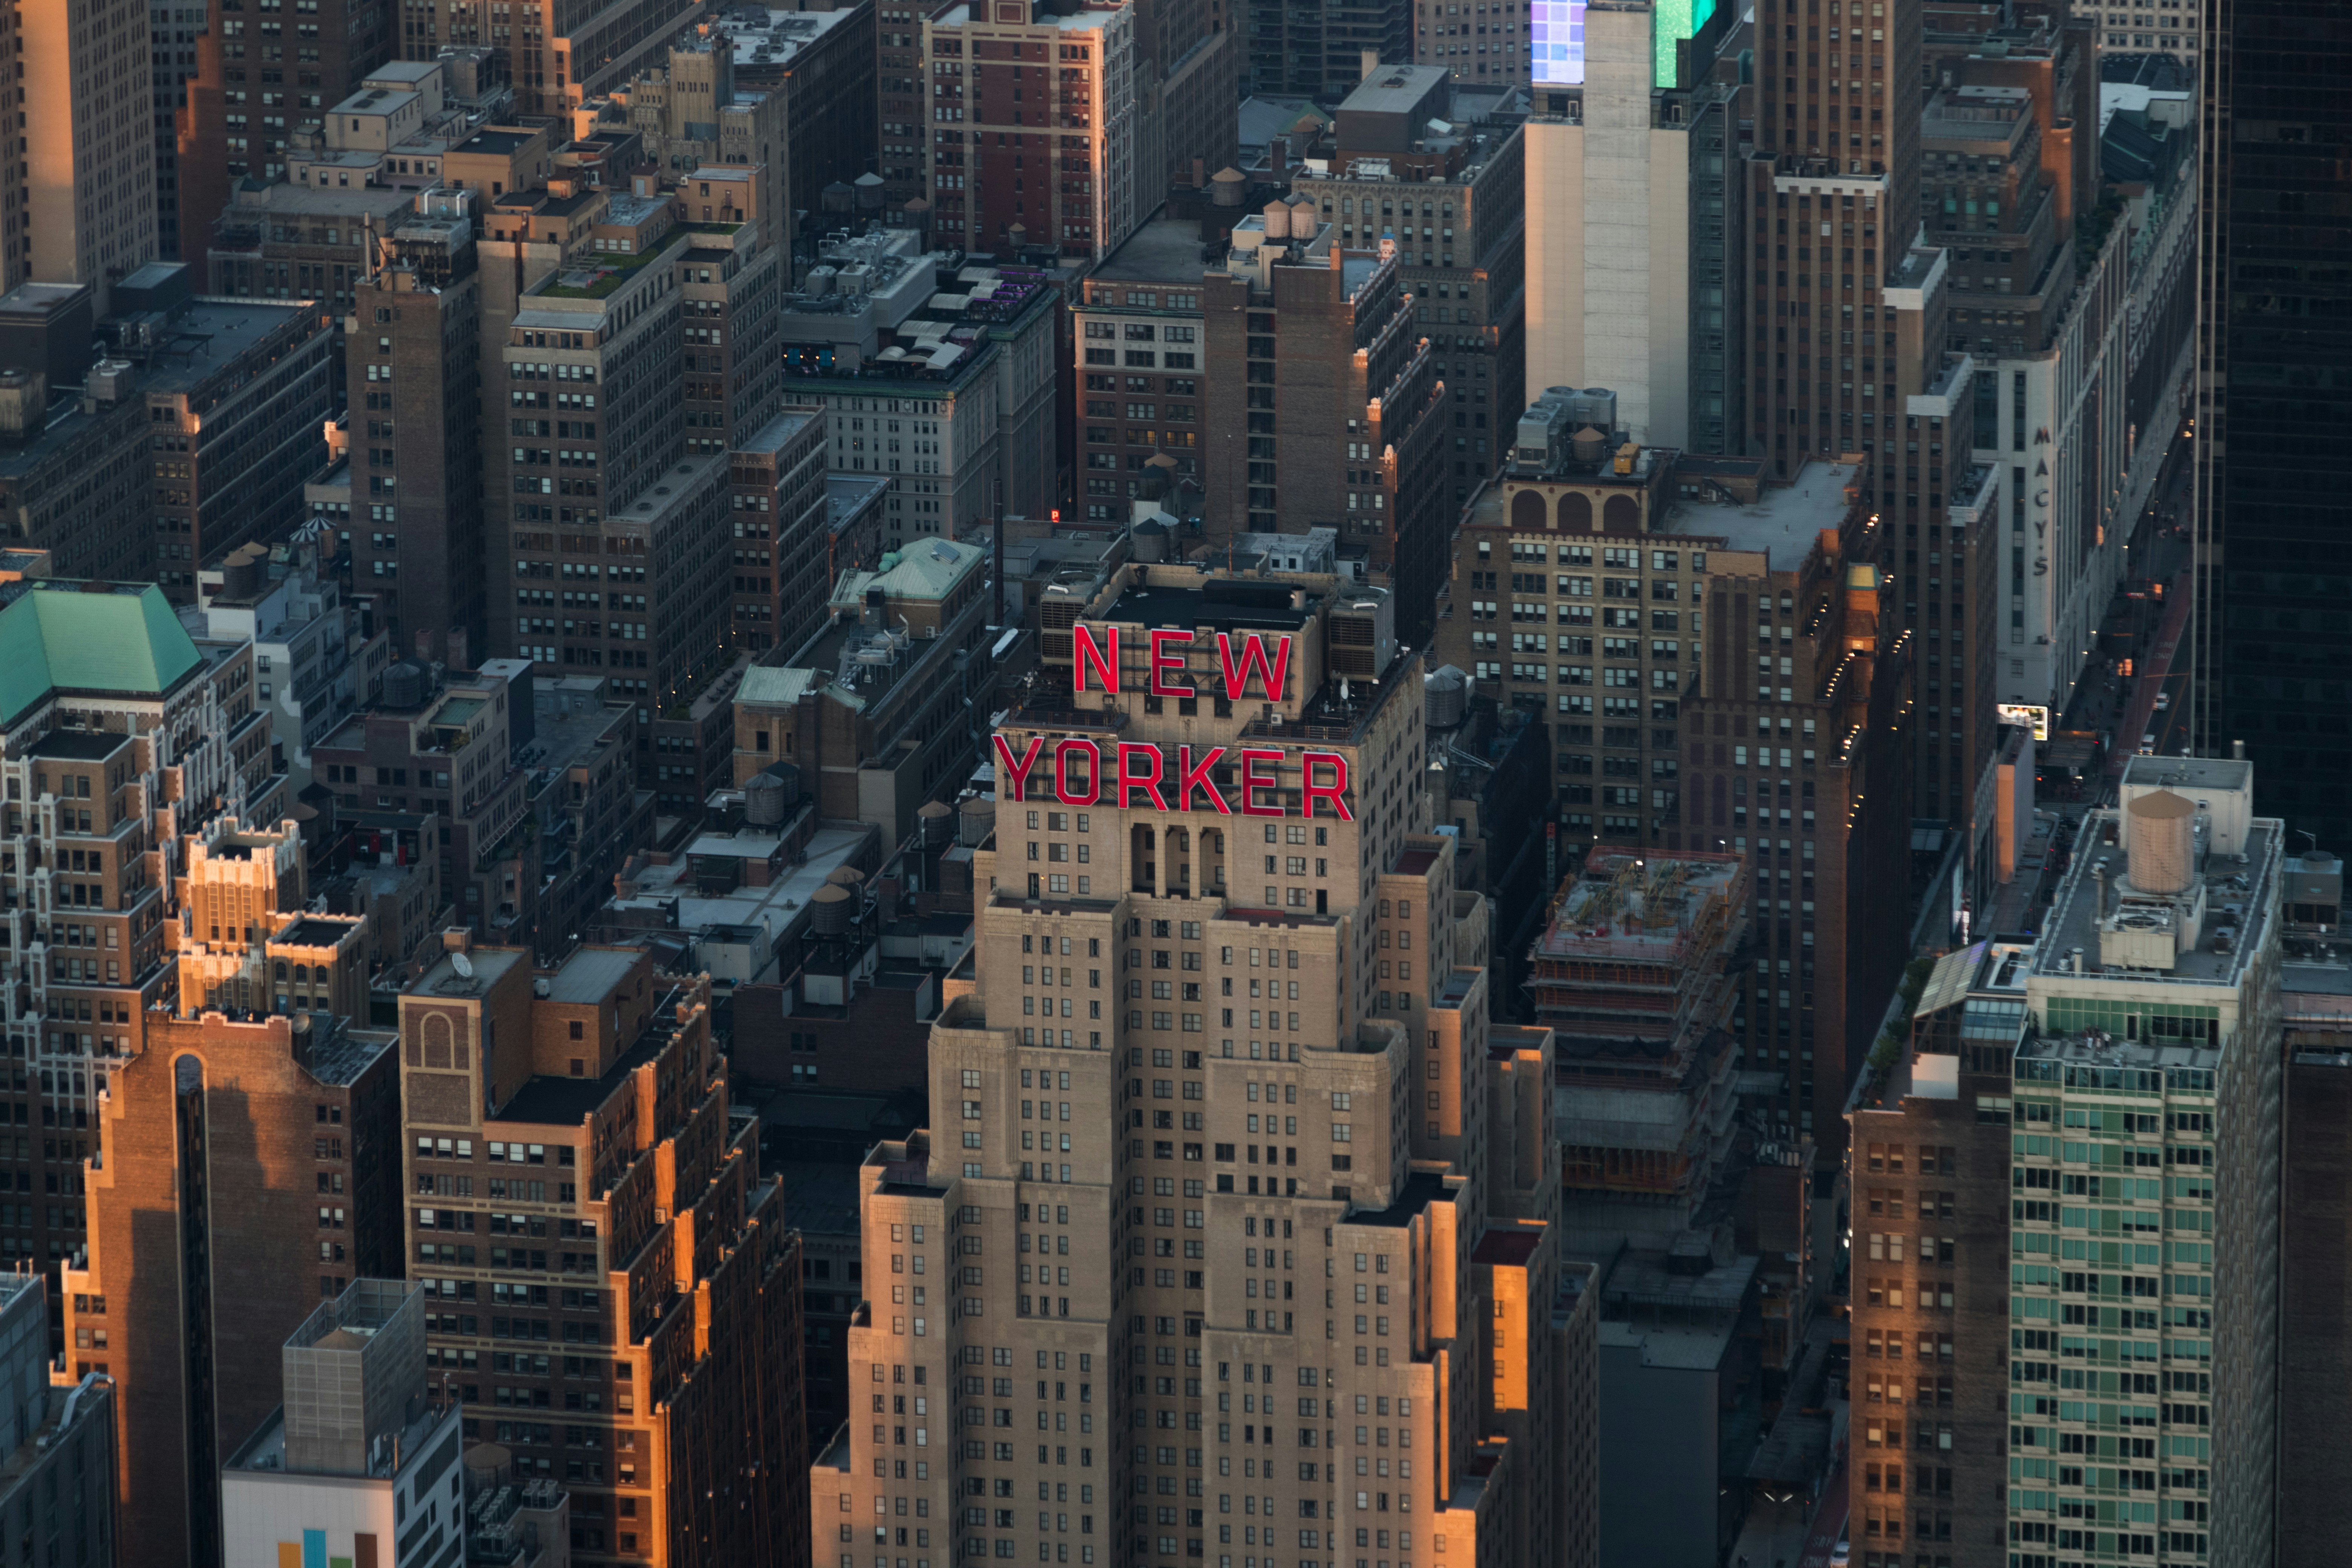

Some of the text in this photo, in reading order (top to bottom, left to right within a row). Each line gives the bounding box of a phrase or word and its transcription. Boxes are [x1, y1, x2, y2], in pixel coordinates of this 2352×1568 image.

[1052, 510, 1059, 520] P
[1073, 624, 1291, 702] NEW
[992, 733, 1354, 821] YORKER
